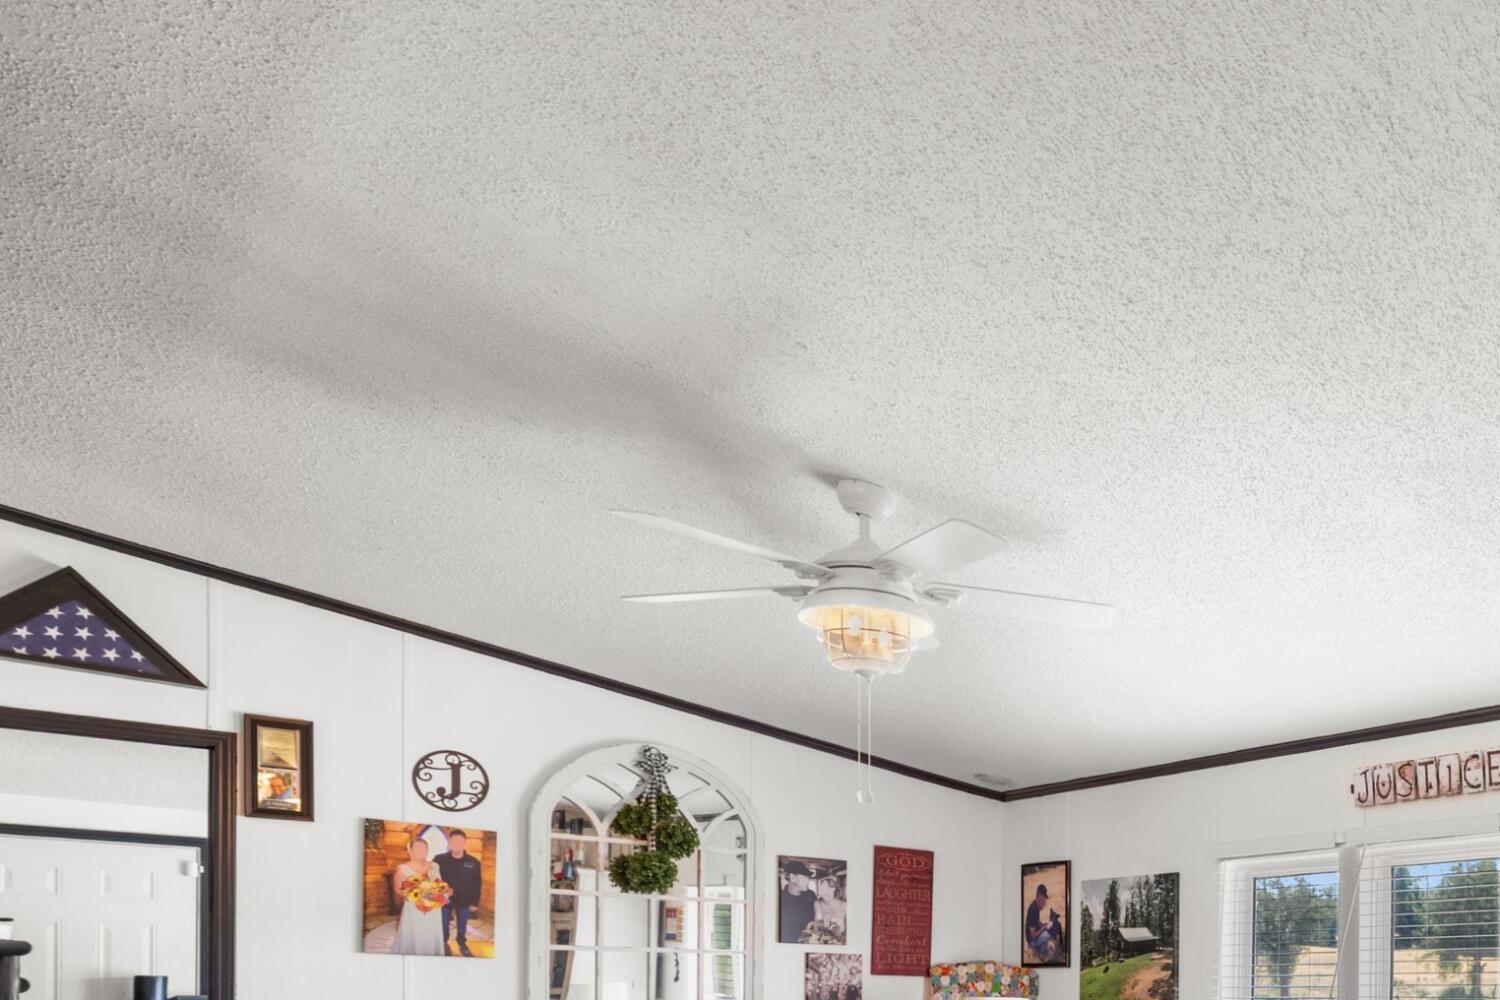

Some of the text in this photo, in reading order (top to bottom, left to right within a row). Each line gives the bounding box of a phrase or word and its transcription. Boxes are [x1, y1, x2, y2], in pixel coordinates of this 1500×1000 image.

[886, 855, 926, 869] GOD
[876, 887, 931, 902] LAUGHTER
[877, 913, 912, 927] RAIN
[877, 952, 928, 965] LIGHT
